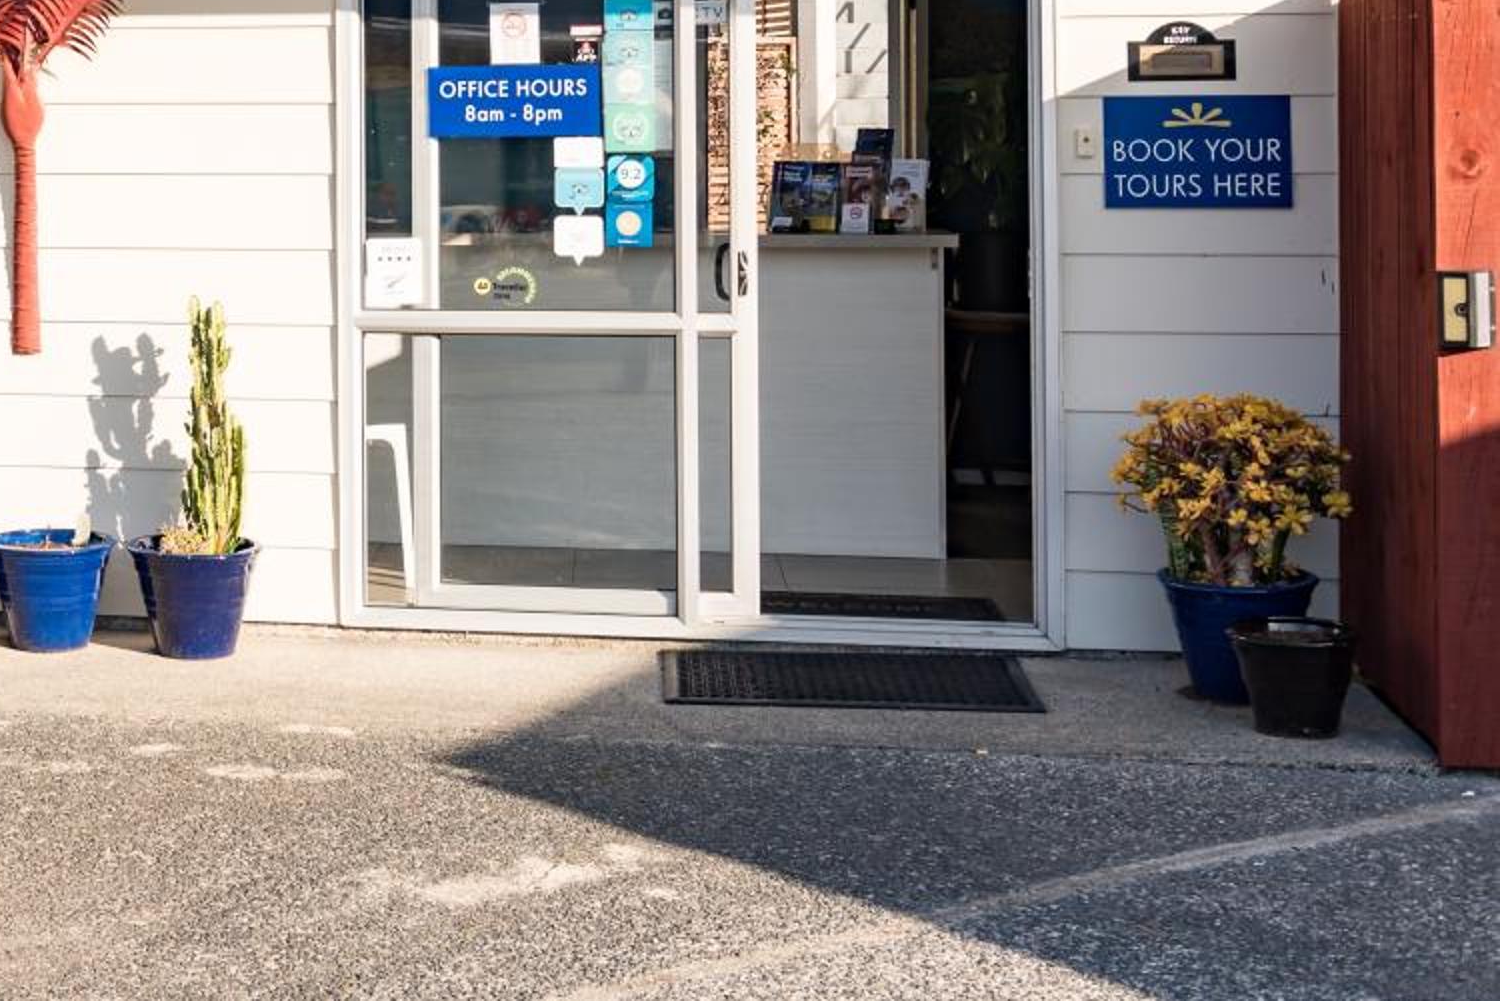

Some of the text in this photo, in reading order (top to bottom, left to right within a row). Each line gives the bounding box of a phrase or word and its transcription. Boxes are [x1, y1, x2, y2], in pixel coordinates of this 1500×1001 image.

[439, 78, 588, 99] OFFICE HOURS
[464, 104, 505, 122] 8am
[522, 103, 563, 126] 8pm
[1112, 137, 1282, 162] BOOK YOUR
[620, 167, 642, 181] 9.2
[1113, 172, 1282, 198] TOURS HERE
